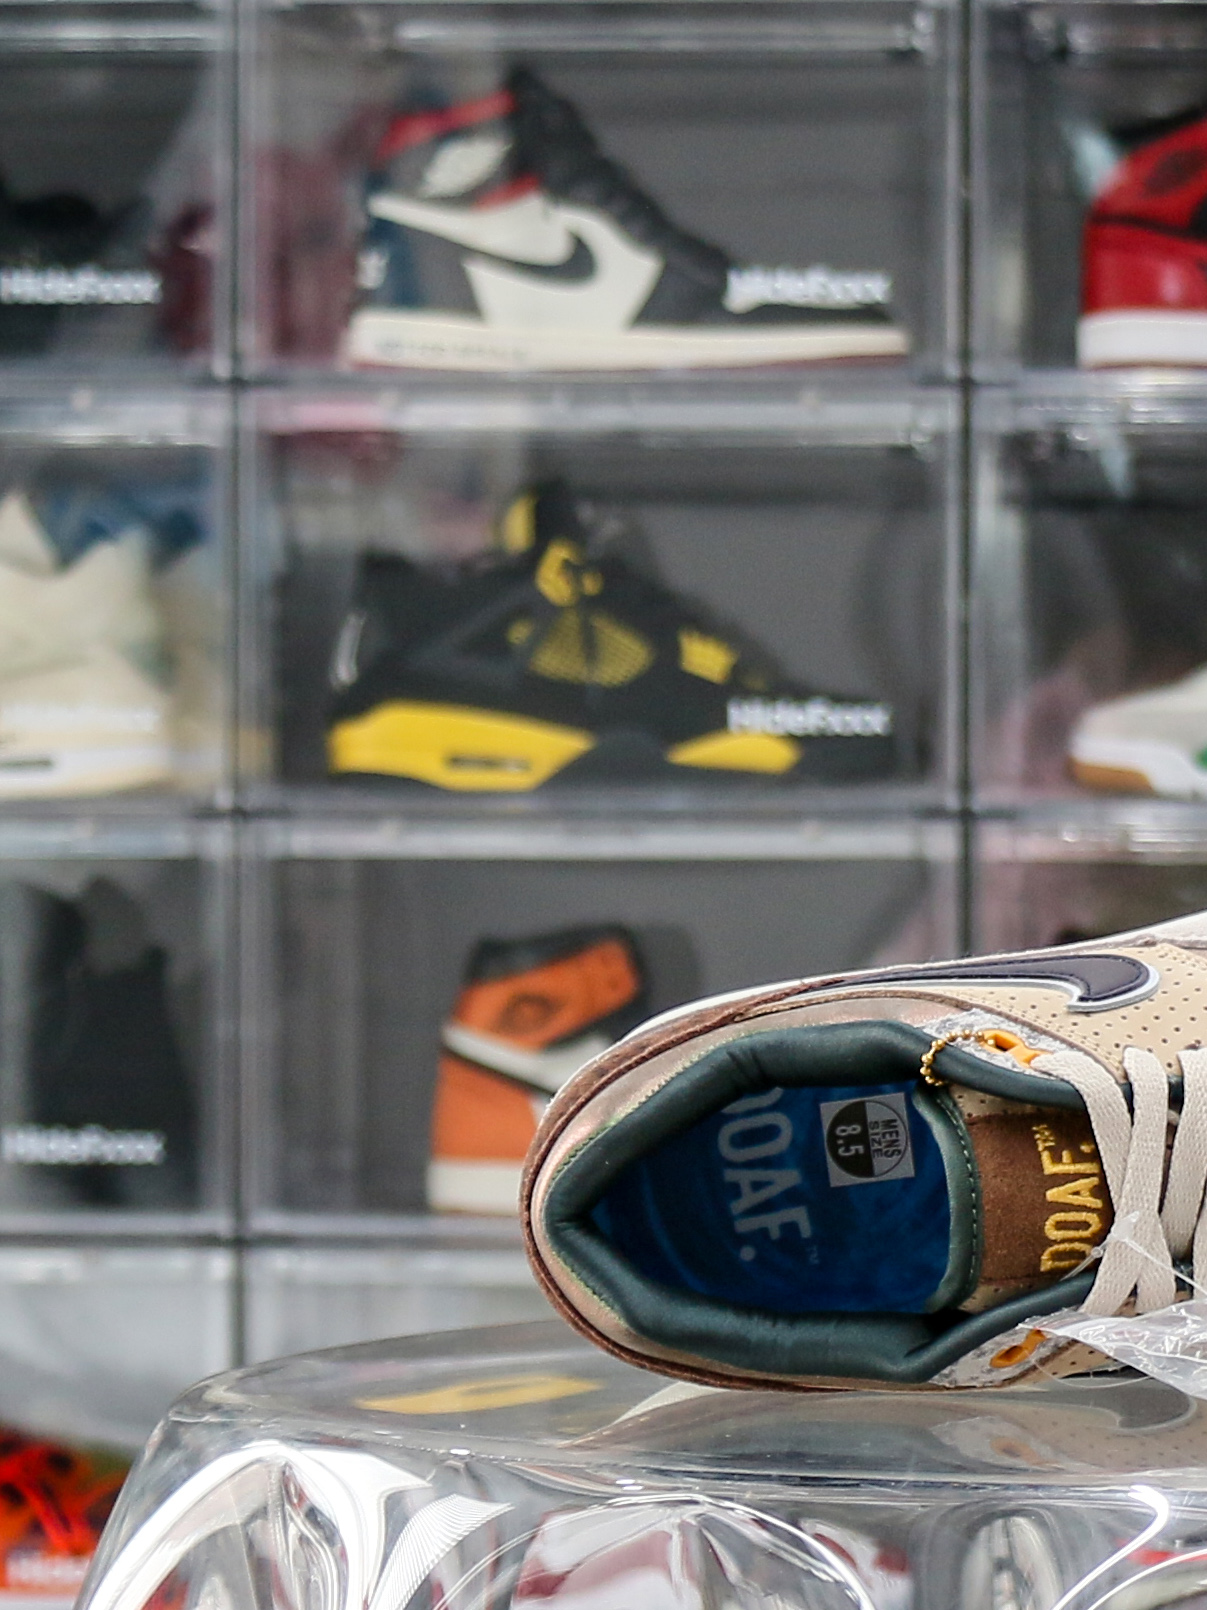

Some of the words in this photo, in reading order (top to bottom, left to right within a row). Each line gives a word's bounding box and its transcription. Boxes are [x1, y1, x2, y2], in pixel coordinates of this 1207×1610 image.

[836, 1124, 865, 1156] 8.5
[869, 1121, 883, 1158] SIZE
[880, 1119, 902, 1158] MENS
